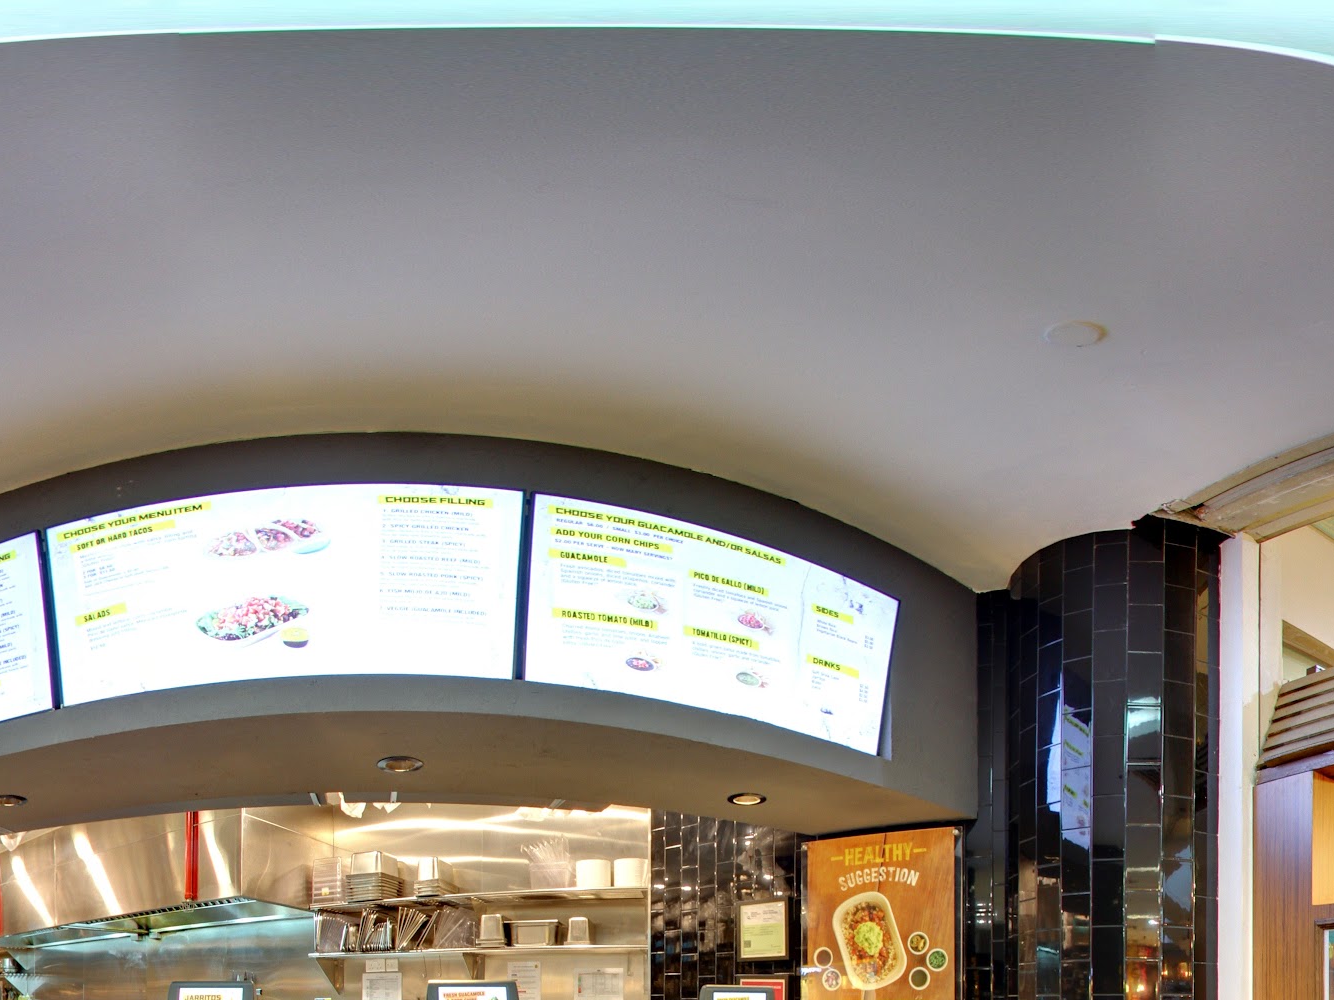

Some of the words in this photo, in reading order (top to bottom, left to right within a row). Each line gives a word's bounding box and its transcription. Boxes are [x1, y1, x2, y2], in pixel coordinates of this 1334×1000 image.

[385, 496, 437, 504] CHOOSE
[439, 497, 485, 506] FILLING
[63, 523, 106, 539] CHOOSE
[107, 516, 137, 528] YOUR
[76, 538, 94, 551] SOFT
[96, 536, 106, 545] OR
[107, 531, 127, 543] HARD
[129, 526, 153, 537] TACOS
[555, 528, 575, 537] ADD
[578, 531, 603, 541] YOUR
[605, 535, 631, 545] CORN
[633, 539, 660, 550] CHIPS
[556, 507, 603, 520] CHOOSE
[606, 515, 635, 526] YOUR
[638, 521, 704, 542] GUACAMOLE
[705, 538, 744, 554] AND/OR
[744, 547, 782, 565] SALSAS
[560, 551, 608, 564] GUACAMOLE
[693, 571, 710, 581] PICO
[711, 575, 719, 583] DE
[721, 577, 742, 589] GALLO
[83, 609, 111, 623] SALADS
[561, 610, 596, 622] ROASTED
[598, 614, 628, 625] TOMATO
[816, 605, 839, 618] SIDES
[692, 627, 727, 641] TOMATILLO
[812, 657, 841, 671] DRINKS
[845, 842, 913, 866] HEALTHY
[838, 866, 920, 892] SUGGESTION
